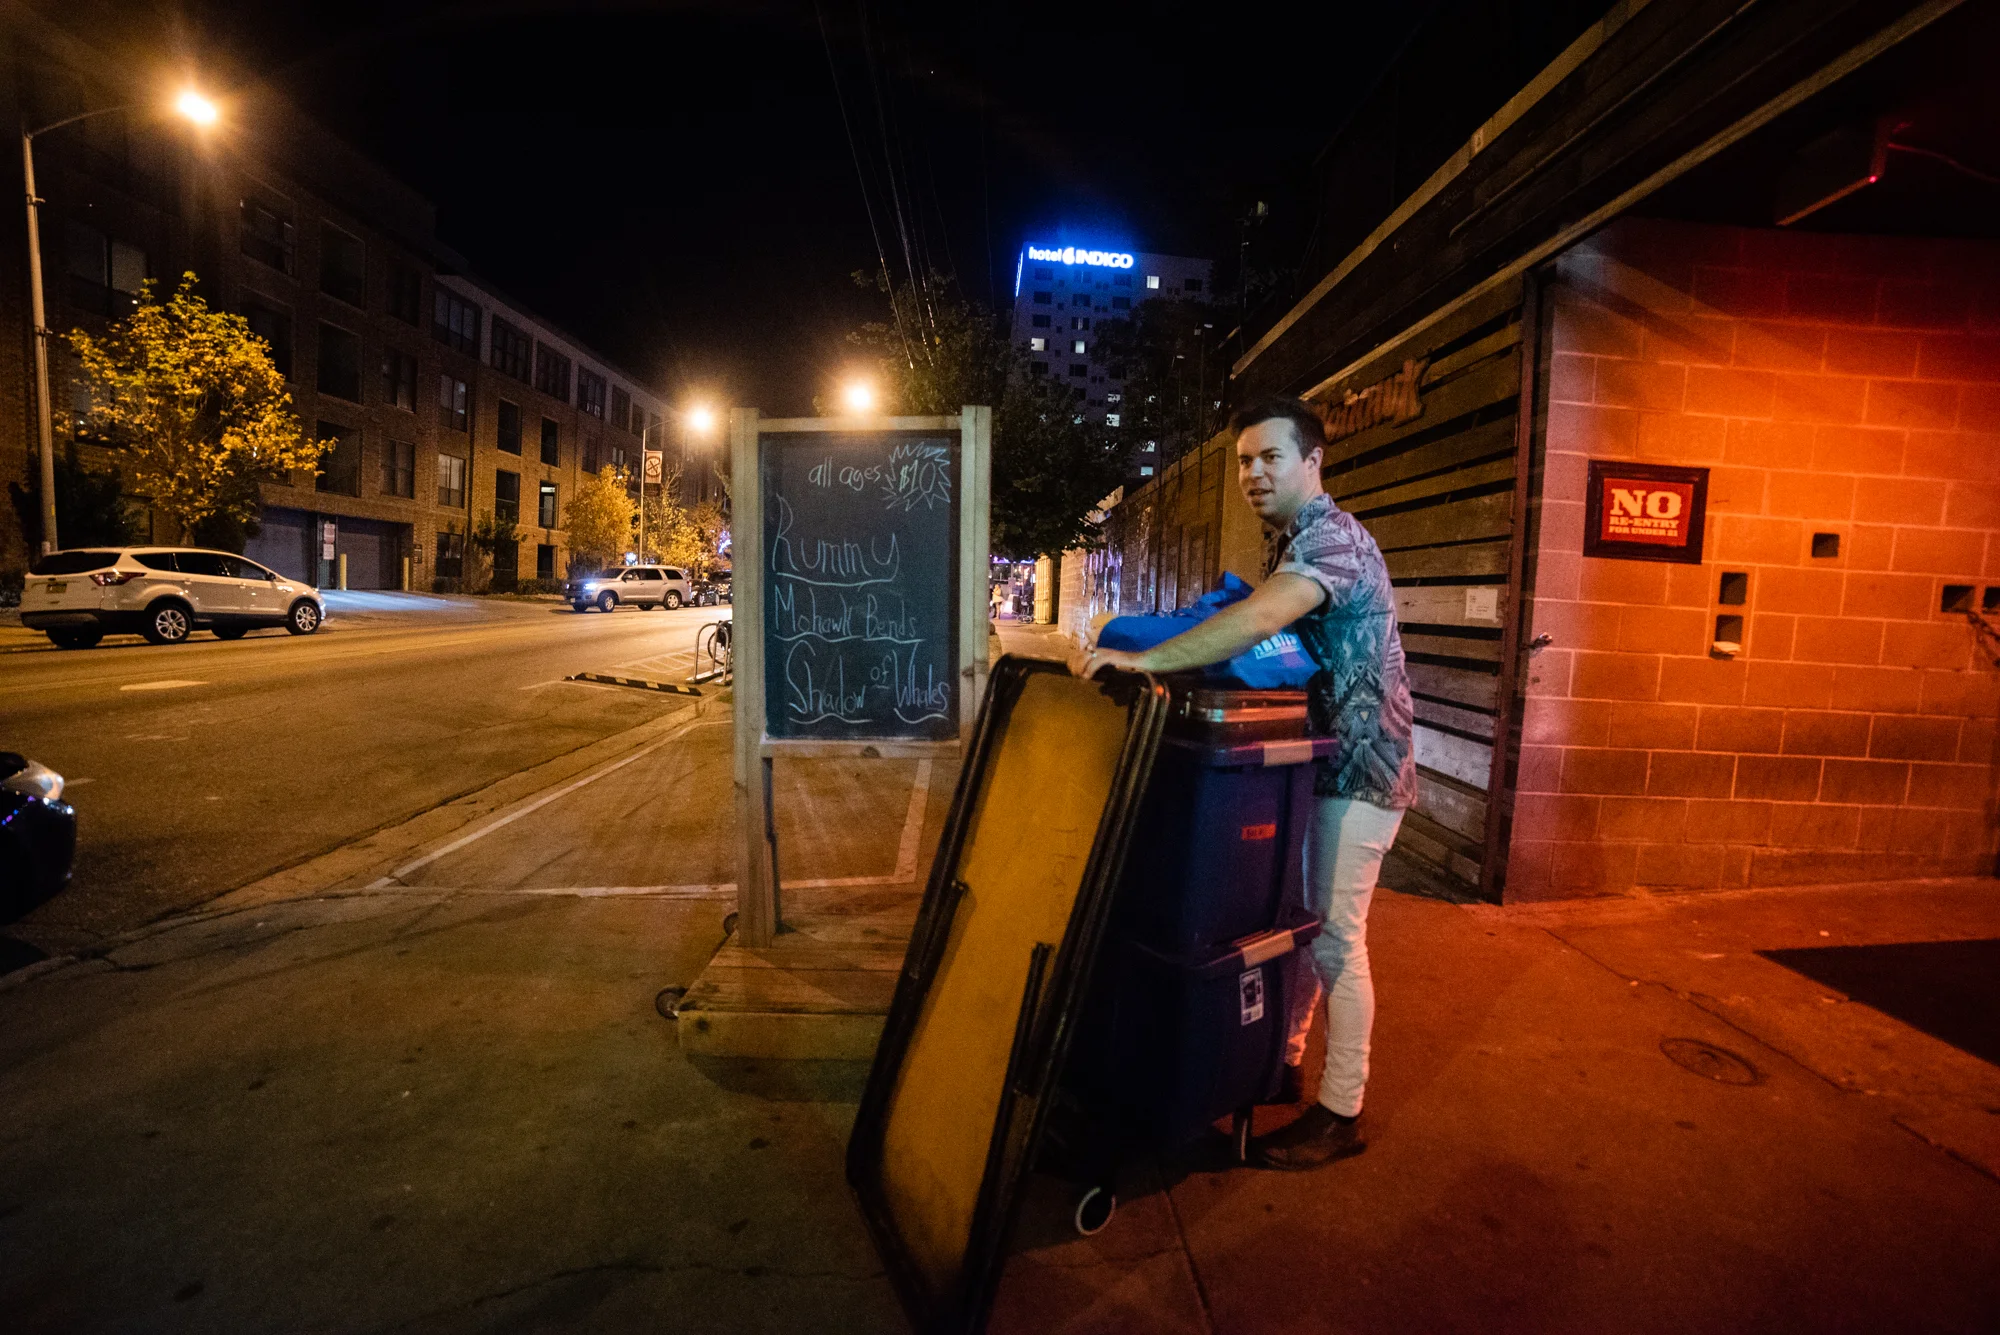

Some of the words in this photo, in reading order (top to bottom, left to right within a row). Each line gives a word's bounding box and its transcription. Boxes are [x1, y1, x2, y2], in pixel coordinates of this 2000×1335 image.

[1028, 246, 1063, 262] hotel
[1075, 249, 1134, 269] INDIGO
[808, 456, 833, 488] all
[840, 464, 881, 491] ages
[899, 459, 937, 494] $10
[1609, 488, 1682, 519] NO
[1609, 516, 1680, 529] RE-ENTRY
[1609, 526, 1630, 534] FOR
[1631, 527, 1666, 537] UNDER
[786, 639, 866, 716] Shadow
[870, 655, 892, 684] of
[892, 641, 950, 713] Whales
